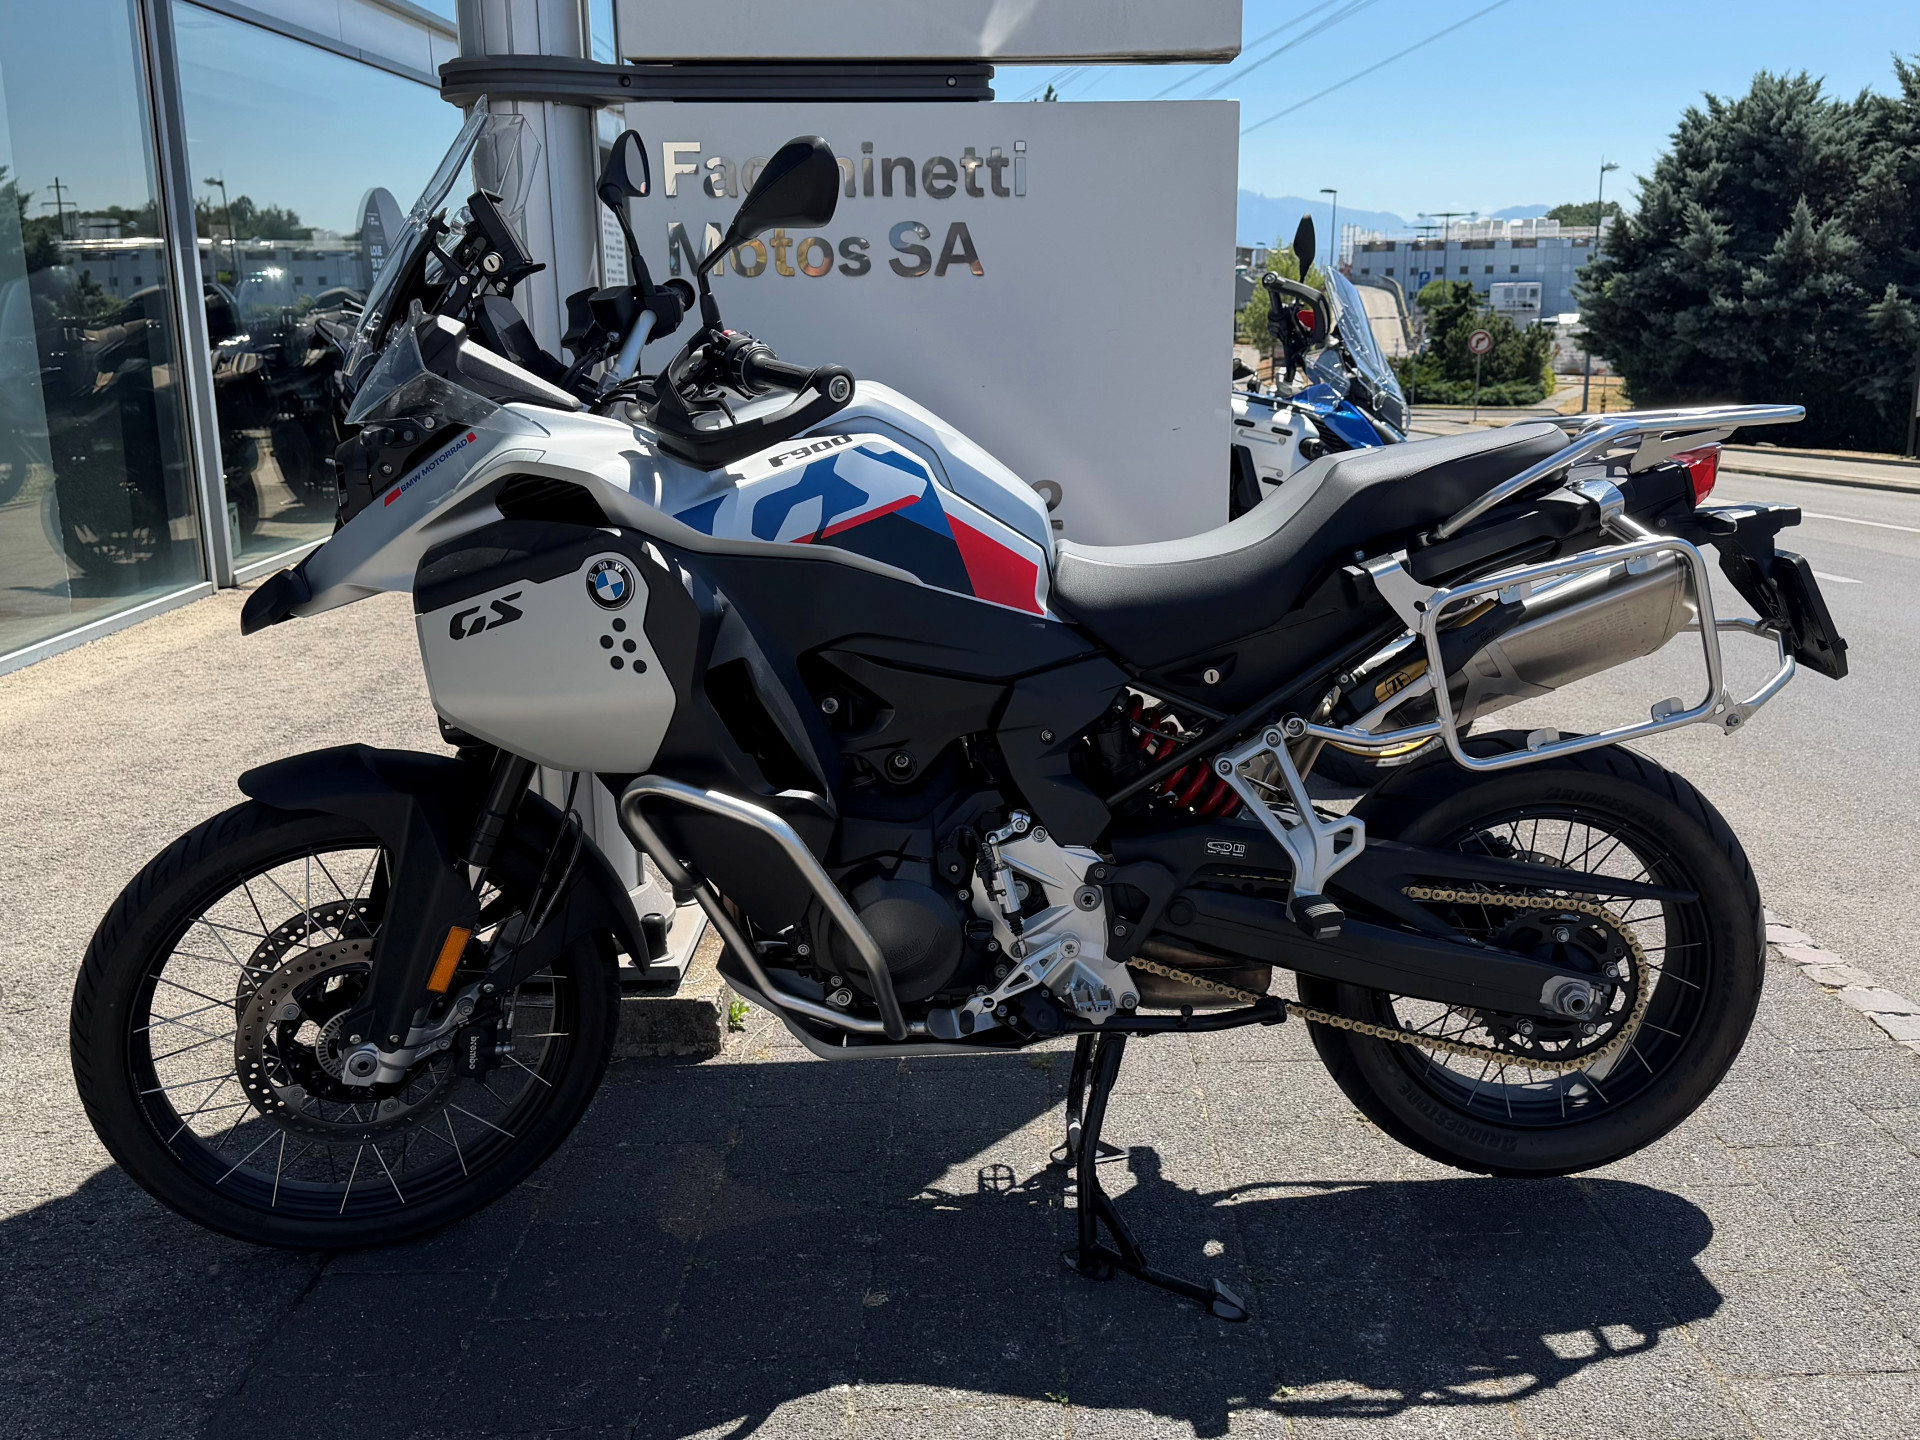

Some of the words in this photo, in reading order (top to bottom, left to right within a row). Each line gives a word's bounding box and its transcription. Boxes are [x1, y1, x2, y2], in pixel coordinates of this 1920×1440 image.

[661, 141, 1027, 199] Facinetti
[666, 221, 872, 277] Motos
[888, 221, 985, 277] SA
[400, 472, 421, 492] BMW
[422, 439, 468, 476] MOTORRAD
[768, 435, 853, 467] F900
[1031, 480, 1064, 530] 2
[588, 561, 625, 583] BMW
[450, 590, 524, 640] GS
[1544, 786, 1677, 842] BRIDGESTONE
[468, 1035, 480, 1070] brembo
[1397, 1080, 1519, 1152] BRIDGESTONE
